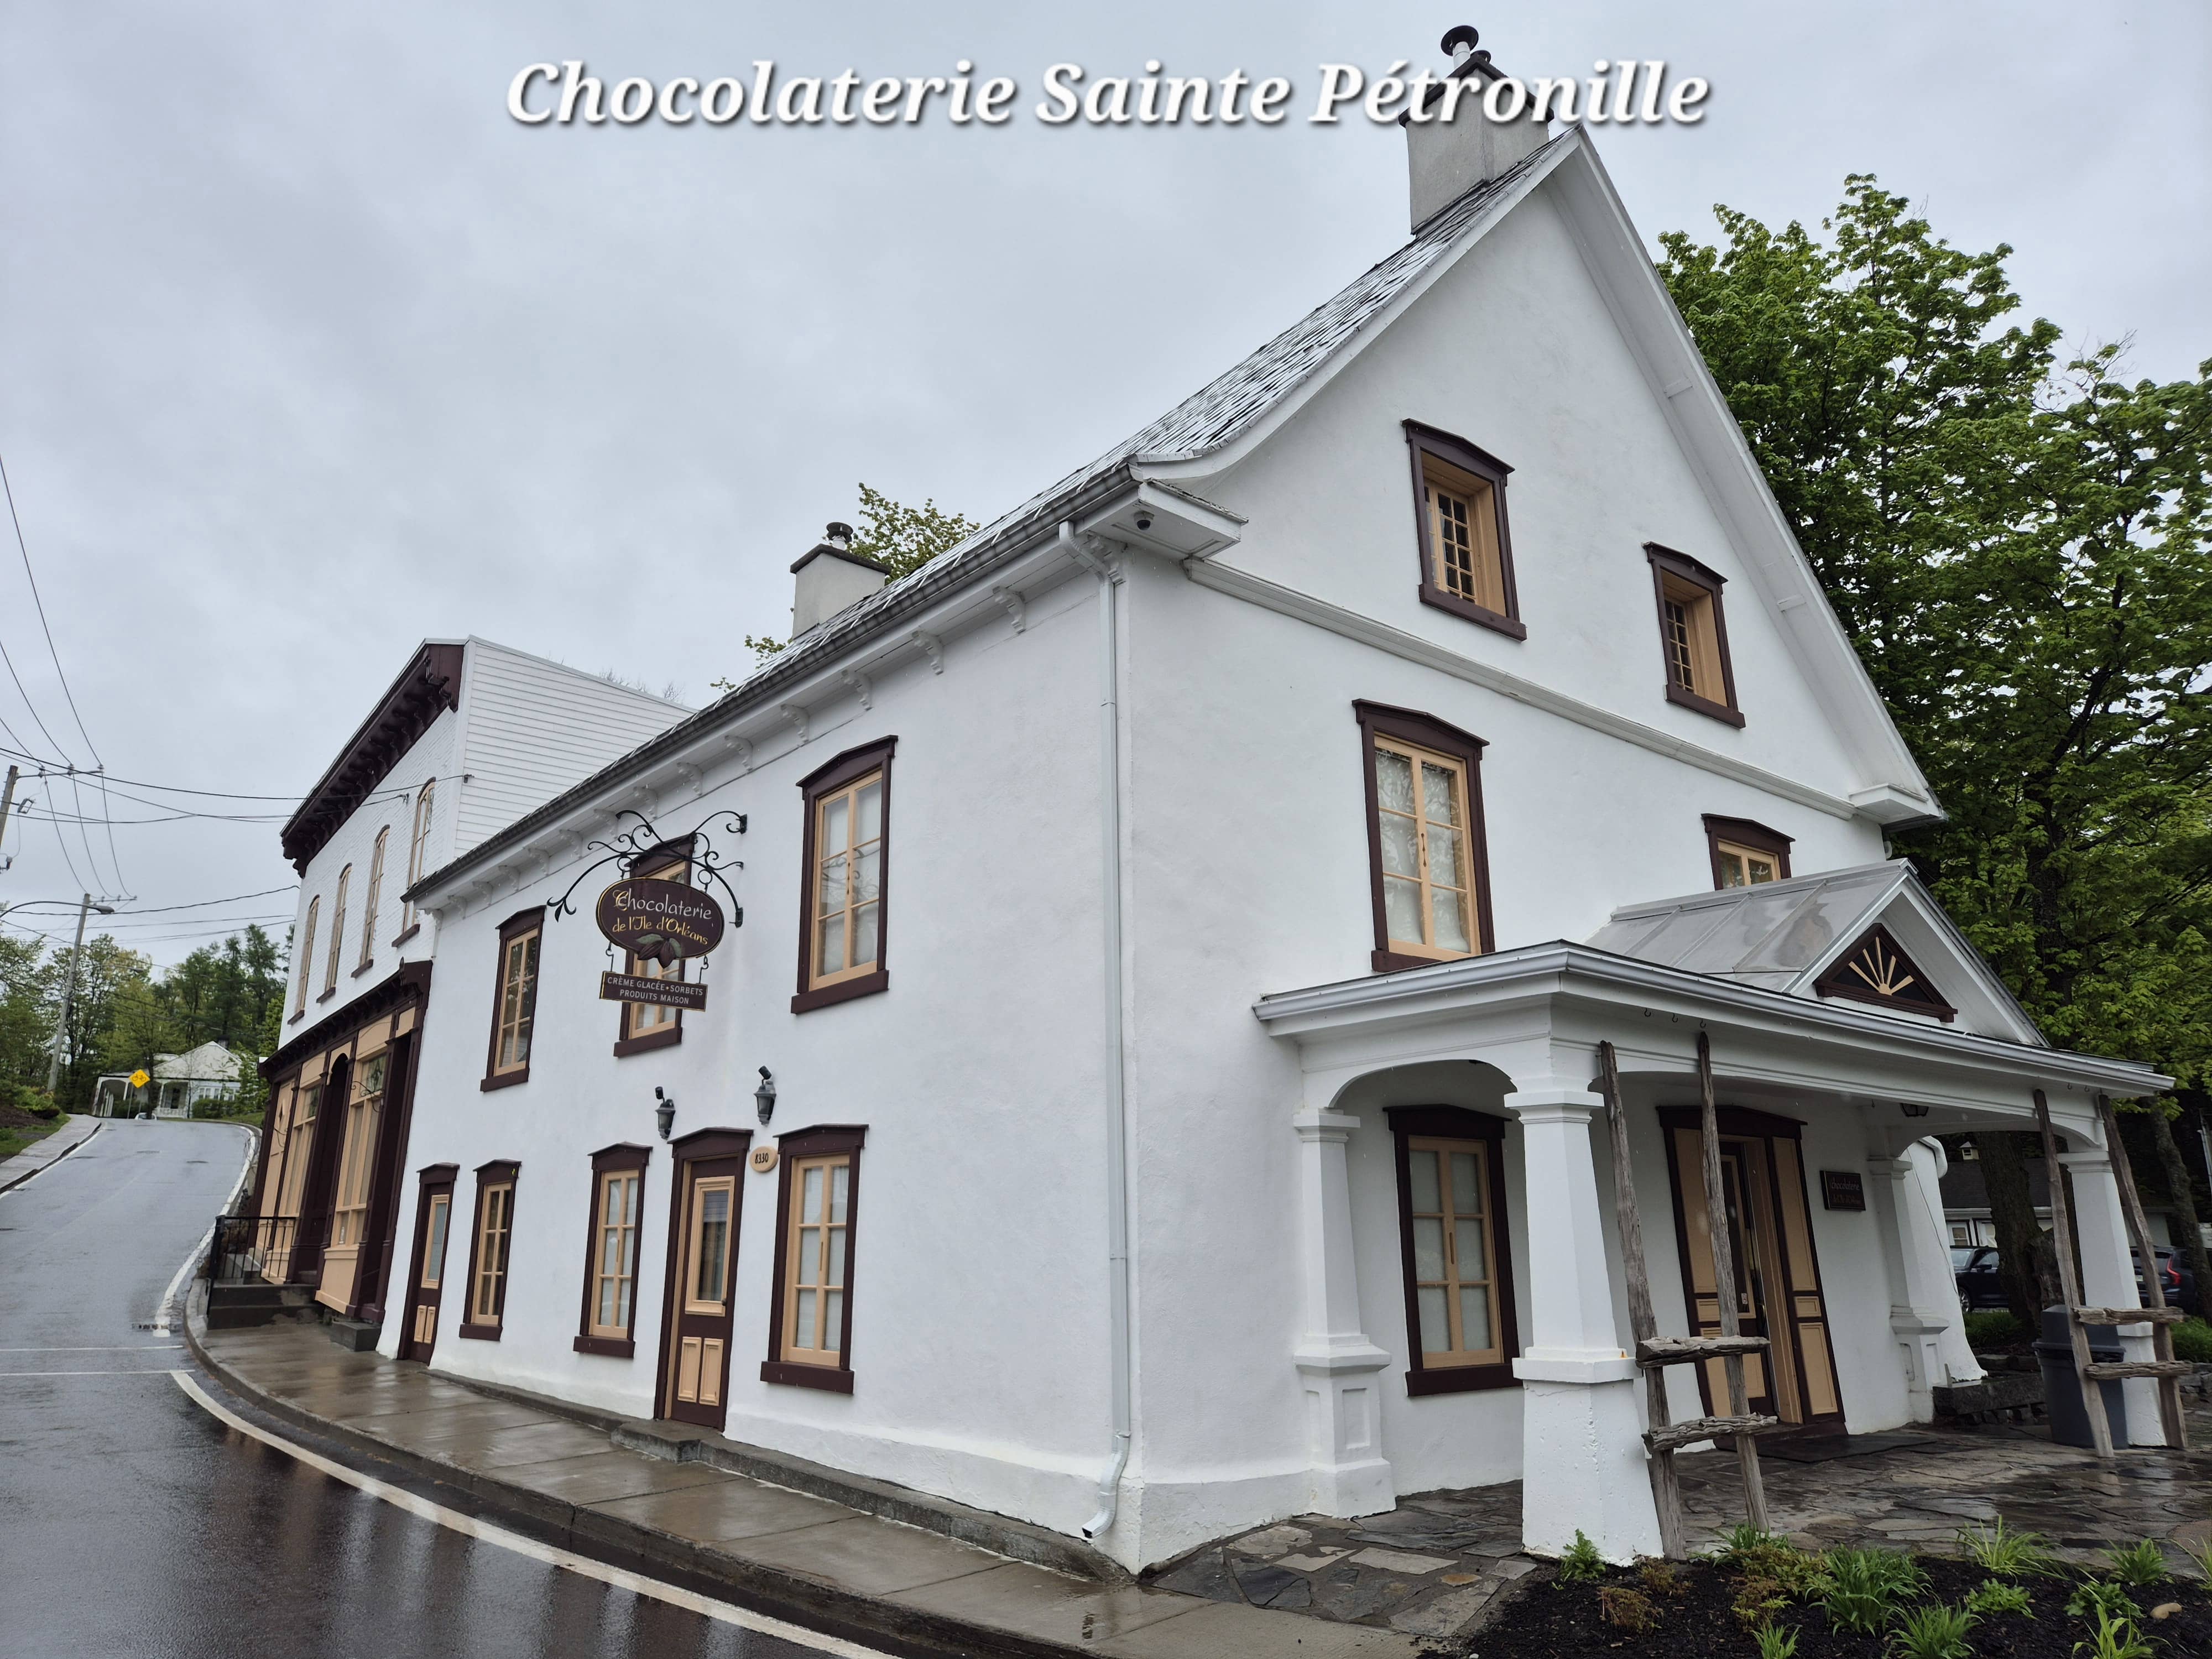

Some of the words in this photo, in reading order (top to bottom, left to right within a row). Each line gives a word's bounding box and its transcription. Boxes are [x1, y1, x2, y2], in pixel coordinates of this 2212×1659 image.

[612, 888, 712, 919] Chocolaterie
[612, 917, 627, 933] de
[656, 916, 708, 945] d'Orléans
[607, 976, 634, 987] CRÈME
[637, 979, 665, 992] GLACÉE
[670, 984, 703, 996] SORBETS
[619, 988, 658, 1000] PRODUITS
[660, 994, 689, 1004] MAISON
[755, 1152, 769, 1164] 8330
